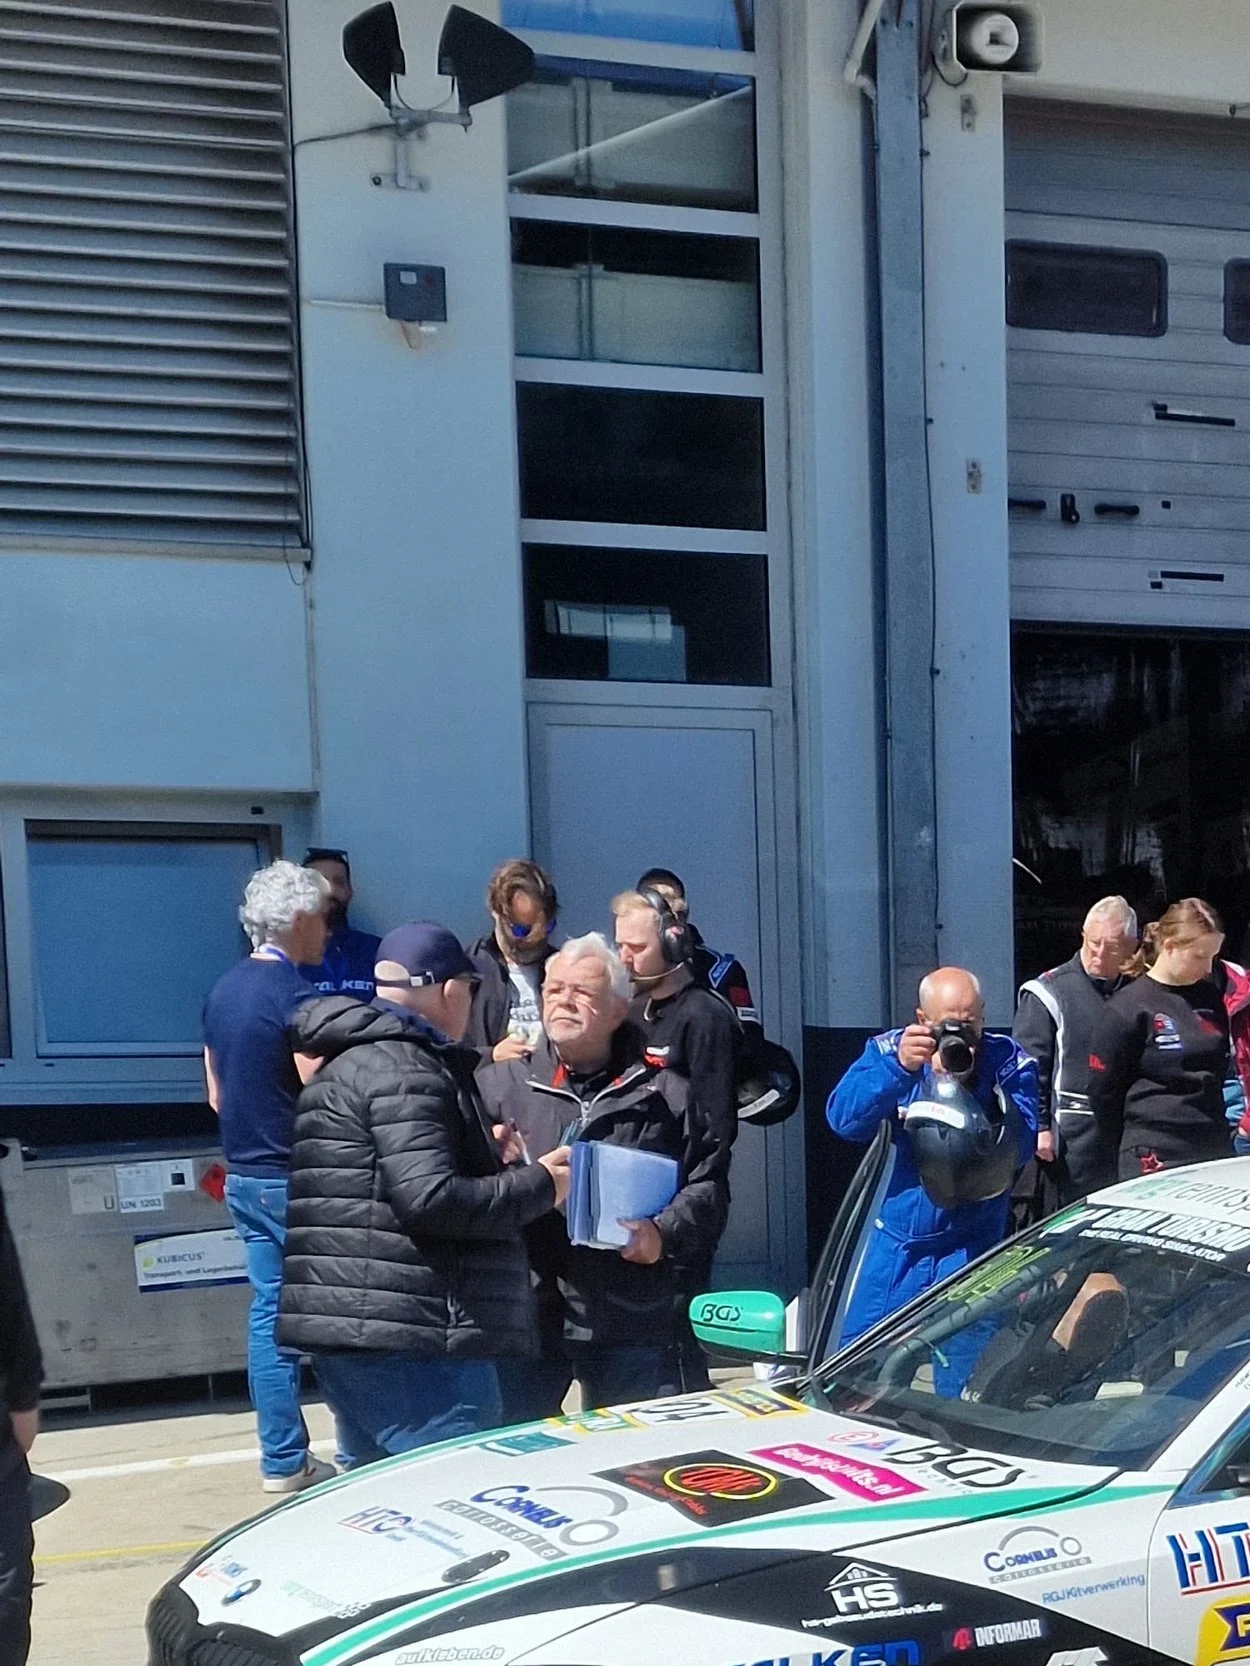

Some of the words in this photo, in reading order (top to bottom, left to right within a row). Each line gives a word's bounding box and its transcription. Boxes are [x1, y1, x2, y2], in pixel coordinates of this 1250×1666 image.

[156, 1252, 203, 1265] KUBICUS
[831, 1582, 899, 1612] HS
[395, 1644, 505, 1666] aufkleben.de
